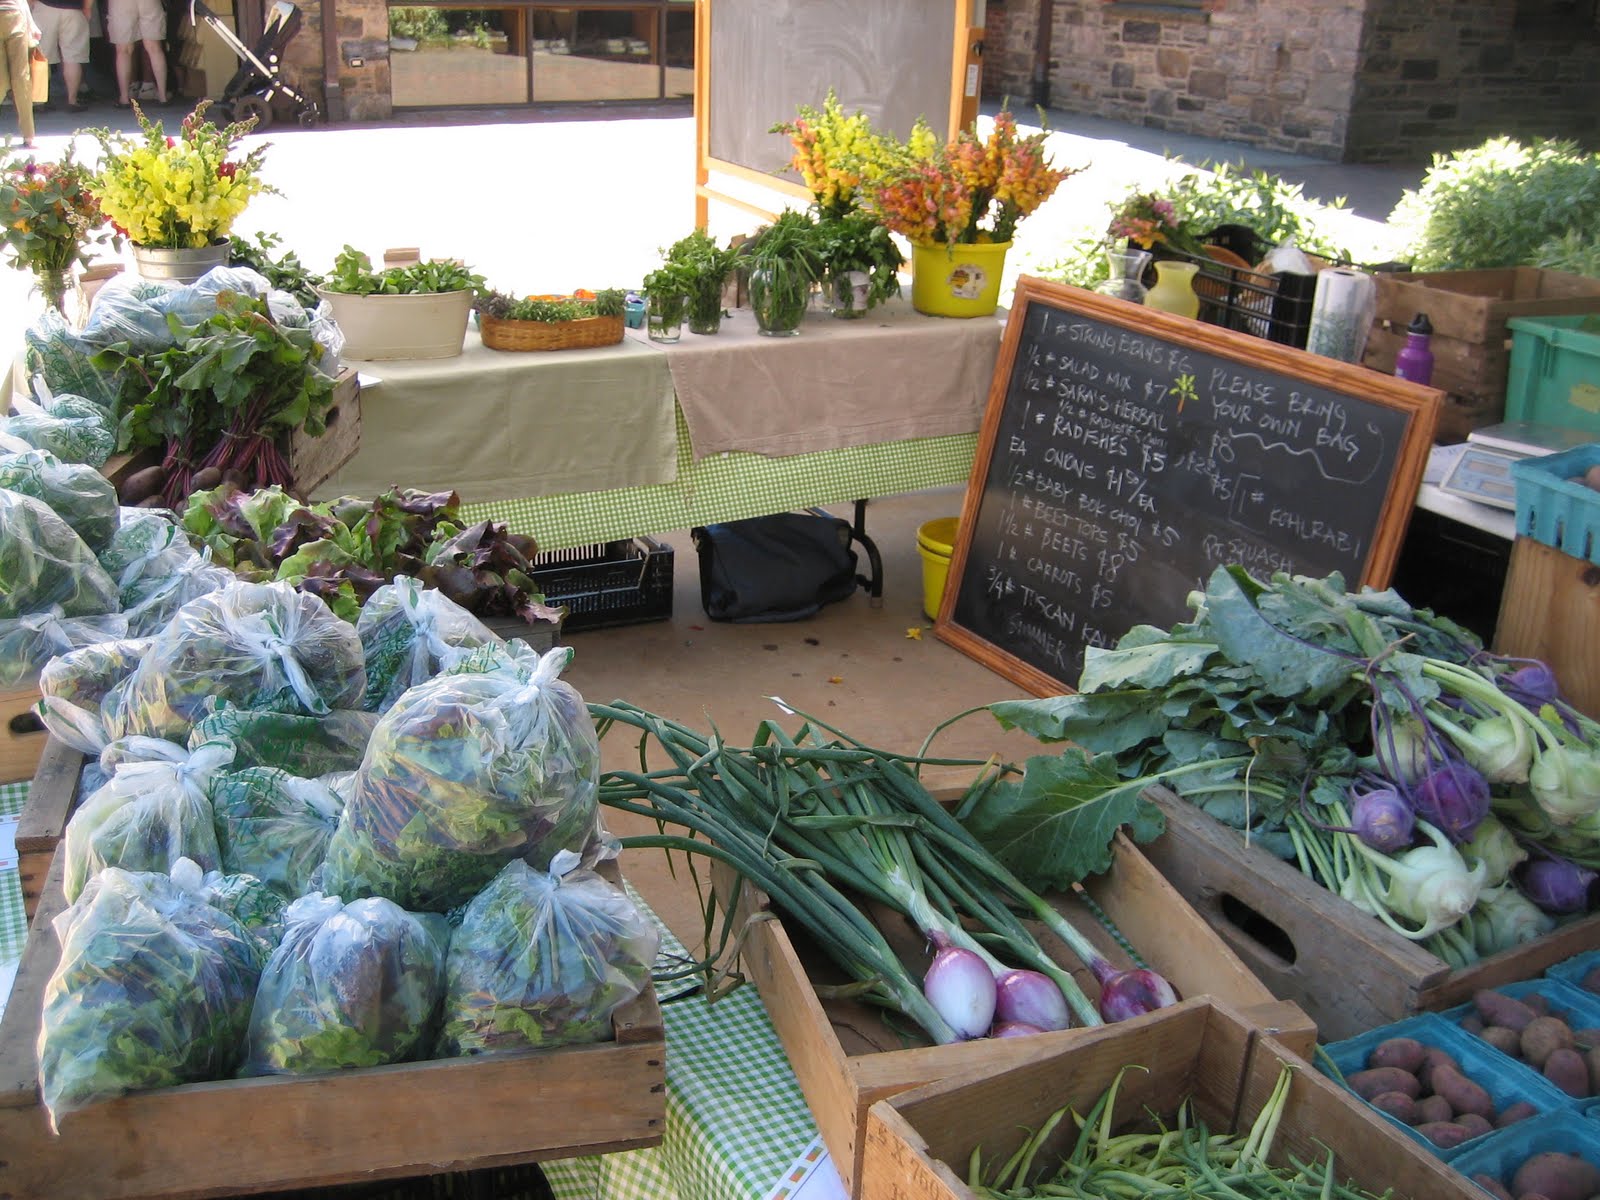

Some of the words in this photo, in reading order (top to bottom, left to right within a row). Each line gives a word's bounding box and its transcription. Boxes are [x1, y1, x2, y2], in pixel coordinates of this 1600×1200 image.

[1069, 323, 1116, 352] STRING
[1118, 333, 1163, 364] BEANS
[1058, 378, 1109, 411] SARA'S
[1114, 400, 1167, 431] HERBAL
[1059, 356, 1099, 380] SALAD
[1105, 372, 1132, 392] MIX
[1144, 378, 1168, 404] $7
[1209, 367, 1275, 404] PLEASE
[1288, 391, 1347, 431] BRING
[1052, 413, 1128, 456] RADISHES
[1141, 444, 1168, 472] $5
[1212, 395, 1251, 423] YOUR
[1259, 414, 1300, 437] OWN
[1316, 427, 1359, 462] BAG
[1009, 435, 1027, 456] EA
[1044, 448, 1096, 479] ONIONS
[1035, 473, 1072, 503] BABY
[1079, 493, 1106, 517] BOK
[1034, 501, 1071, 528] BEET
[1075, 517, 1108, 544] TOPS
[1117, 532, 1145, 561] $5
[1041, 528, 1088, 560] BEETS
[1097, 549, 1125, 583] $8
[1027, 557, 1082, 594] CARROTS
[1091, 582, 1114, 608] $5
[1228, 538, 1293, 578] SQUASH
